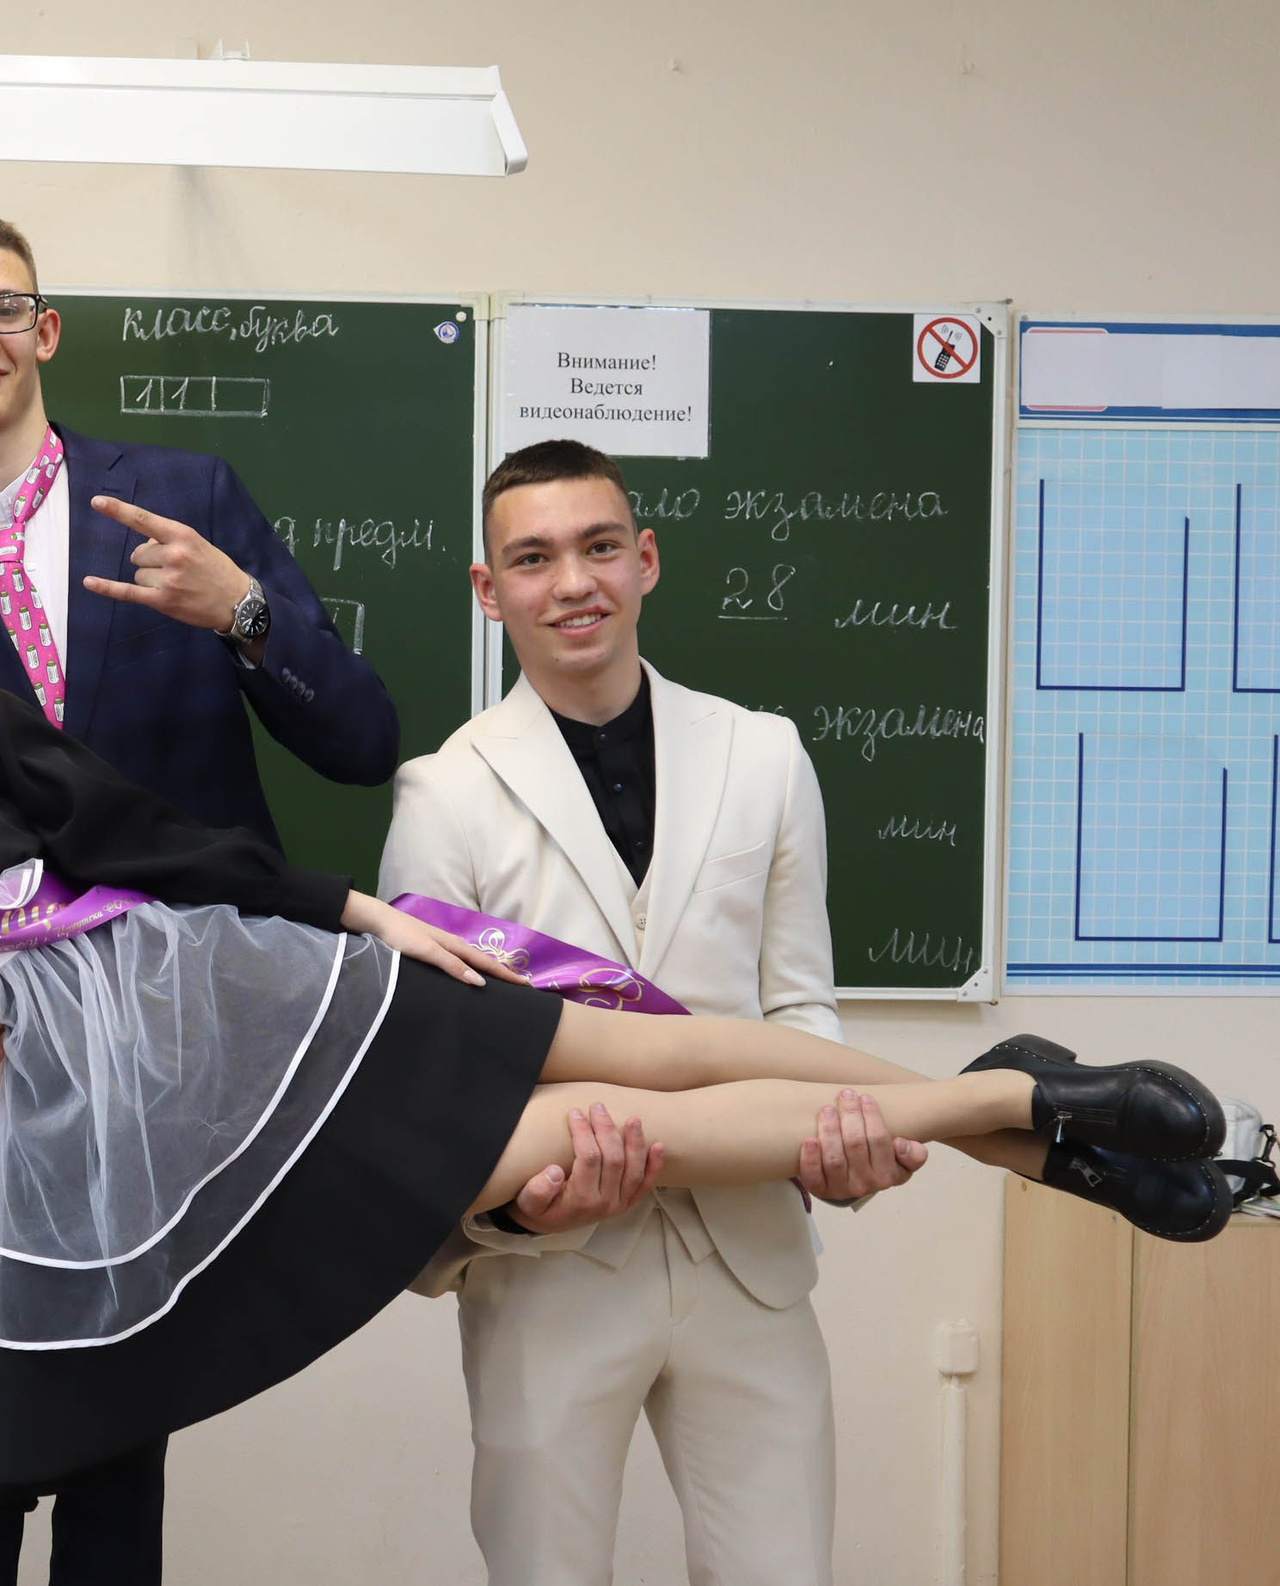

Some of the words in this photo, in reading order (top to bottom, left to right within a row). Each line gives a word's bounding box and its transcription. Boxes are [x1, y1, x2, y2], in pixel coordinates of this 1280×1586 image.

[556, 352, 657, 371] Внимание!
[570, 377, 644, 396] Ведется
[519, 403, 693, 423] видеонаблюдение!
[627, 488, 701, 521] ало
[724, 489, 949, 541] экзамена
[834, 599, 958, 630] мин
[812, 704, 985, 762] экзамена
[878, 814, 957, 848] мин
